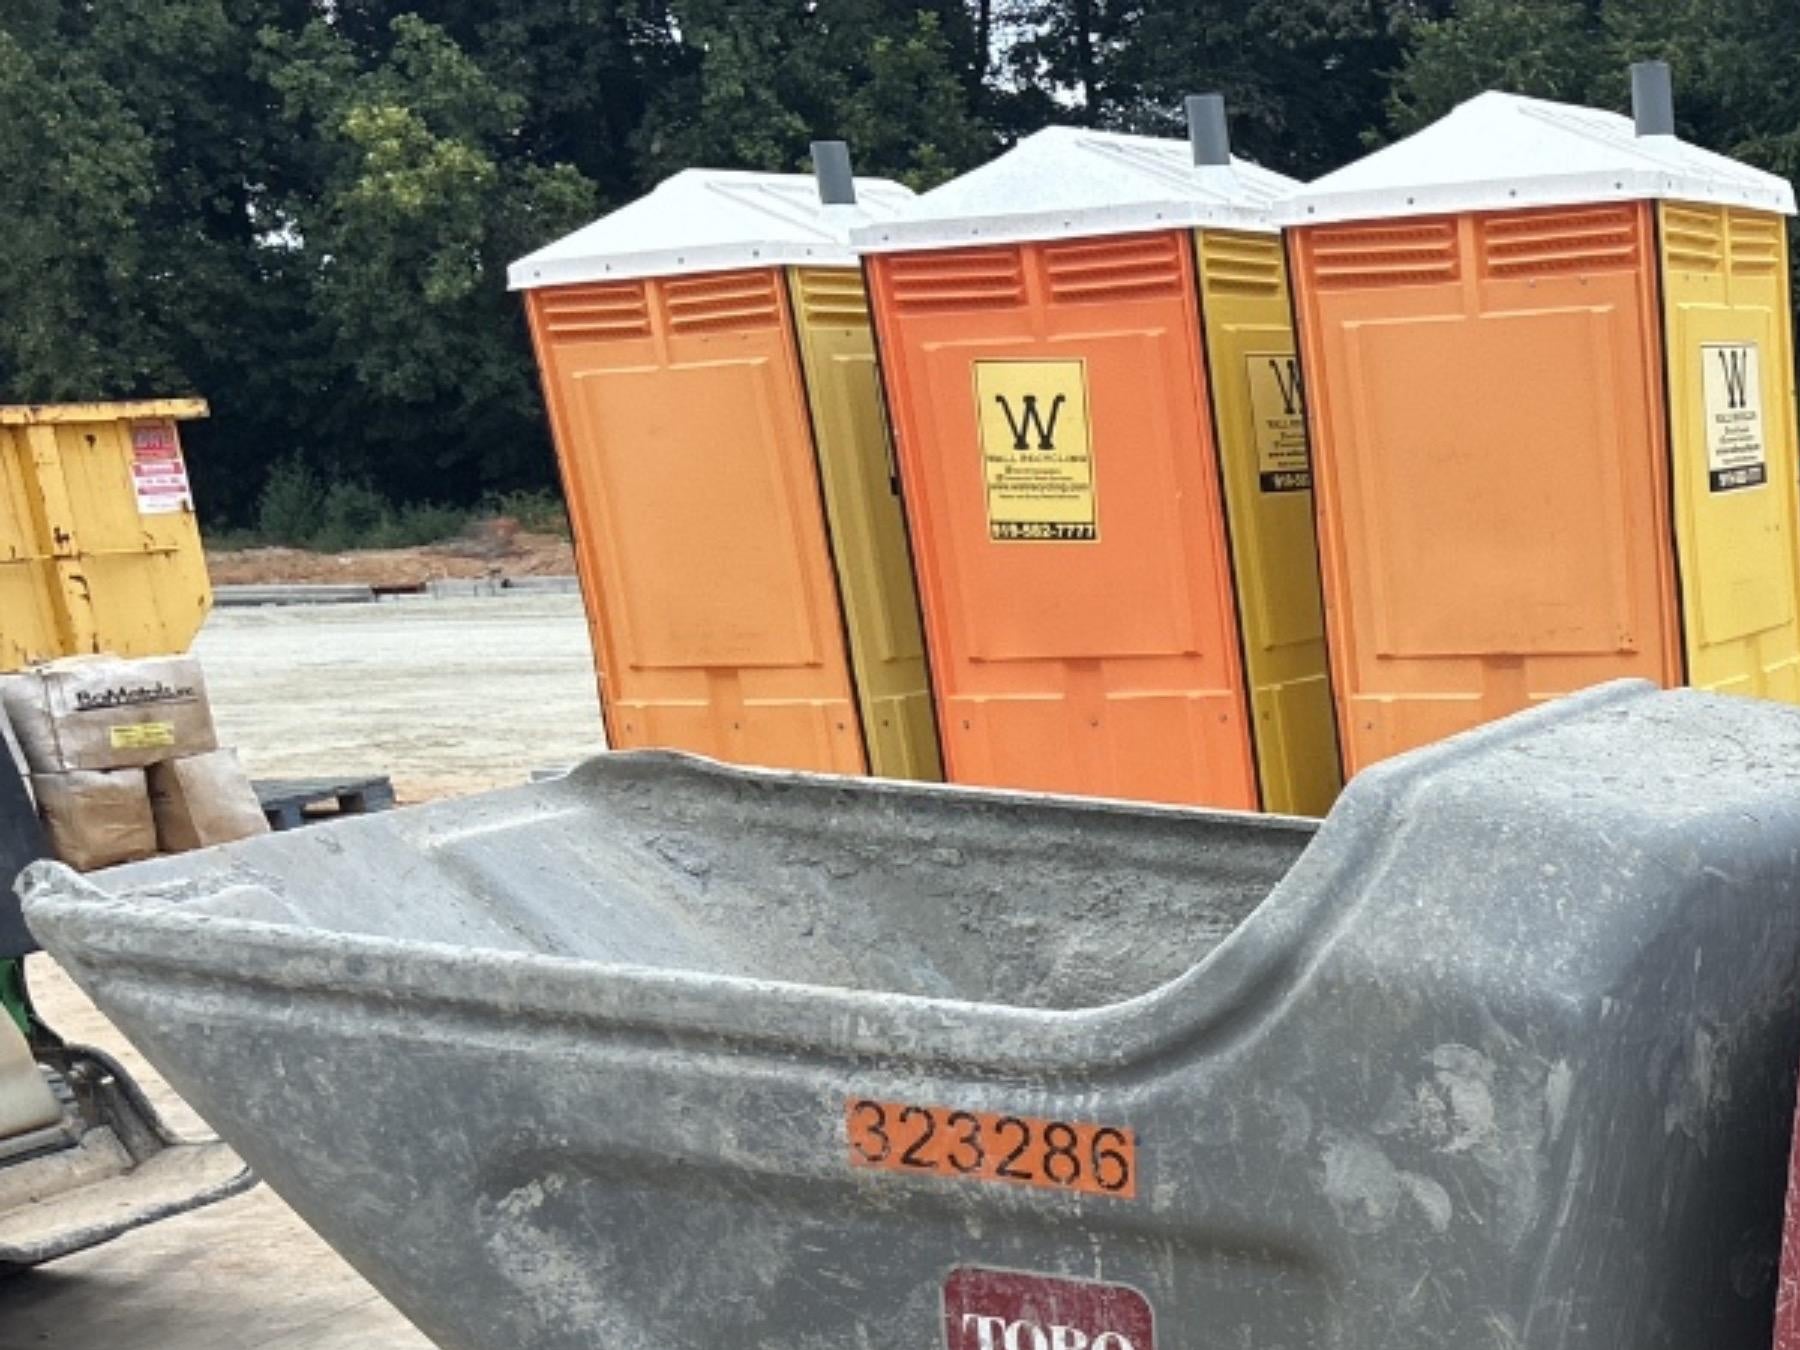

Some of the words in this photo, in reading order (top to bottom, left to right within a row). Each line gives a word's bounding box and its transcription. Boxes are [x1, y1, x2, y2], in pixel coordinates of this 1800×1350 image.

[1717, 349, 1747, 408] W
[994, 394, 1066, 450] W
[852, 1099, 1131, 1191] 323286
